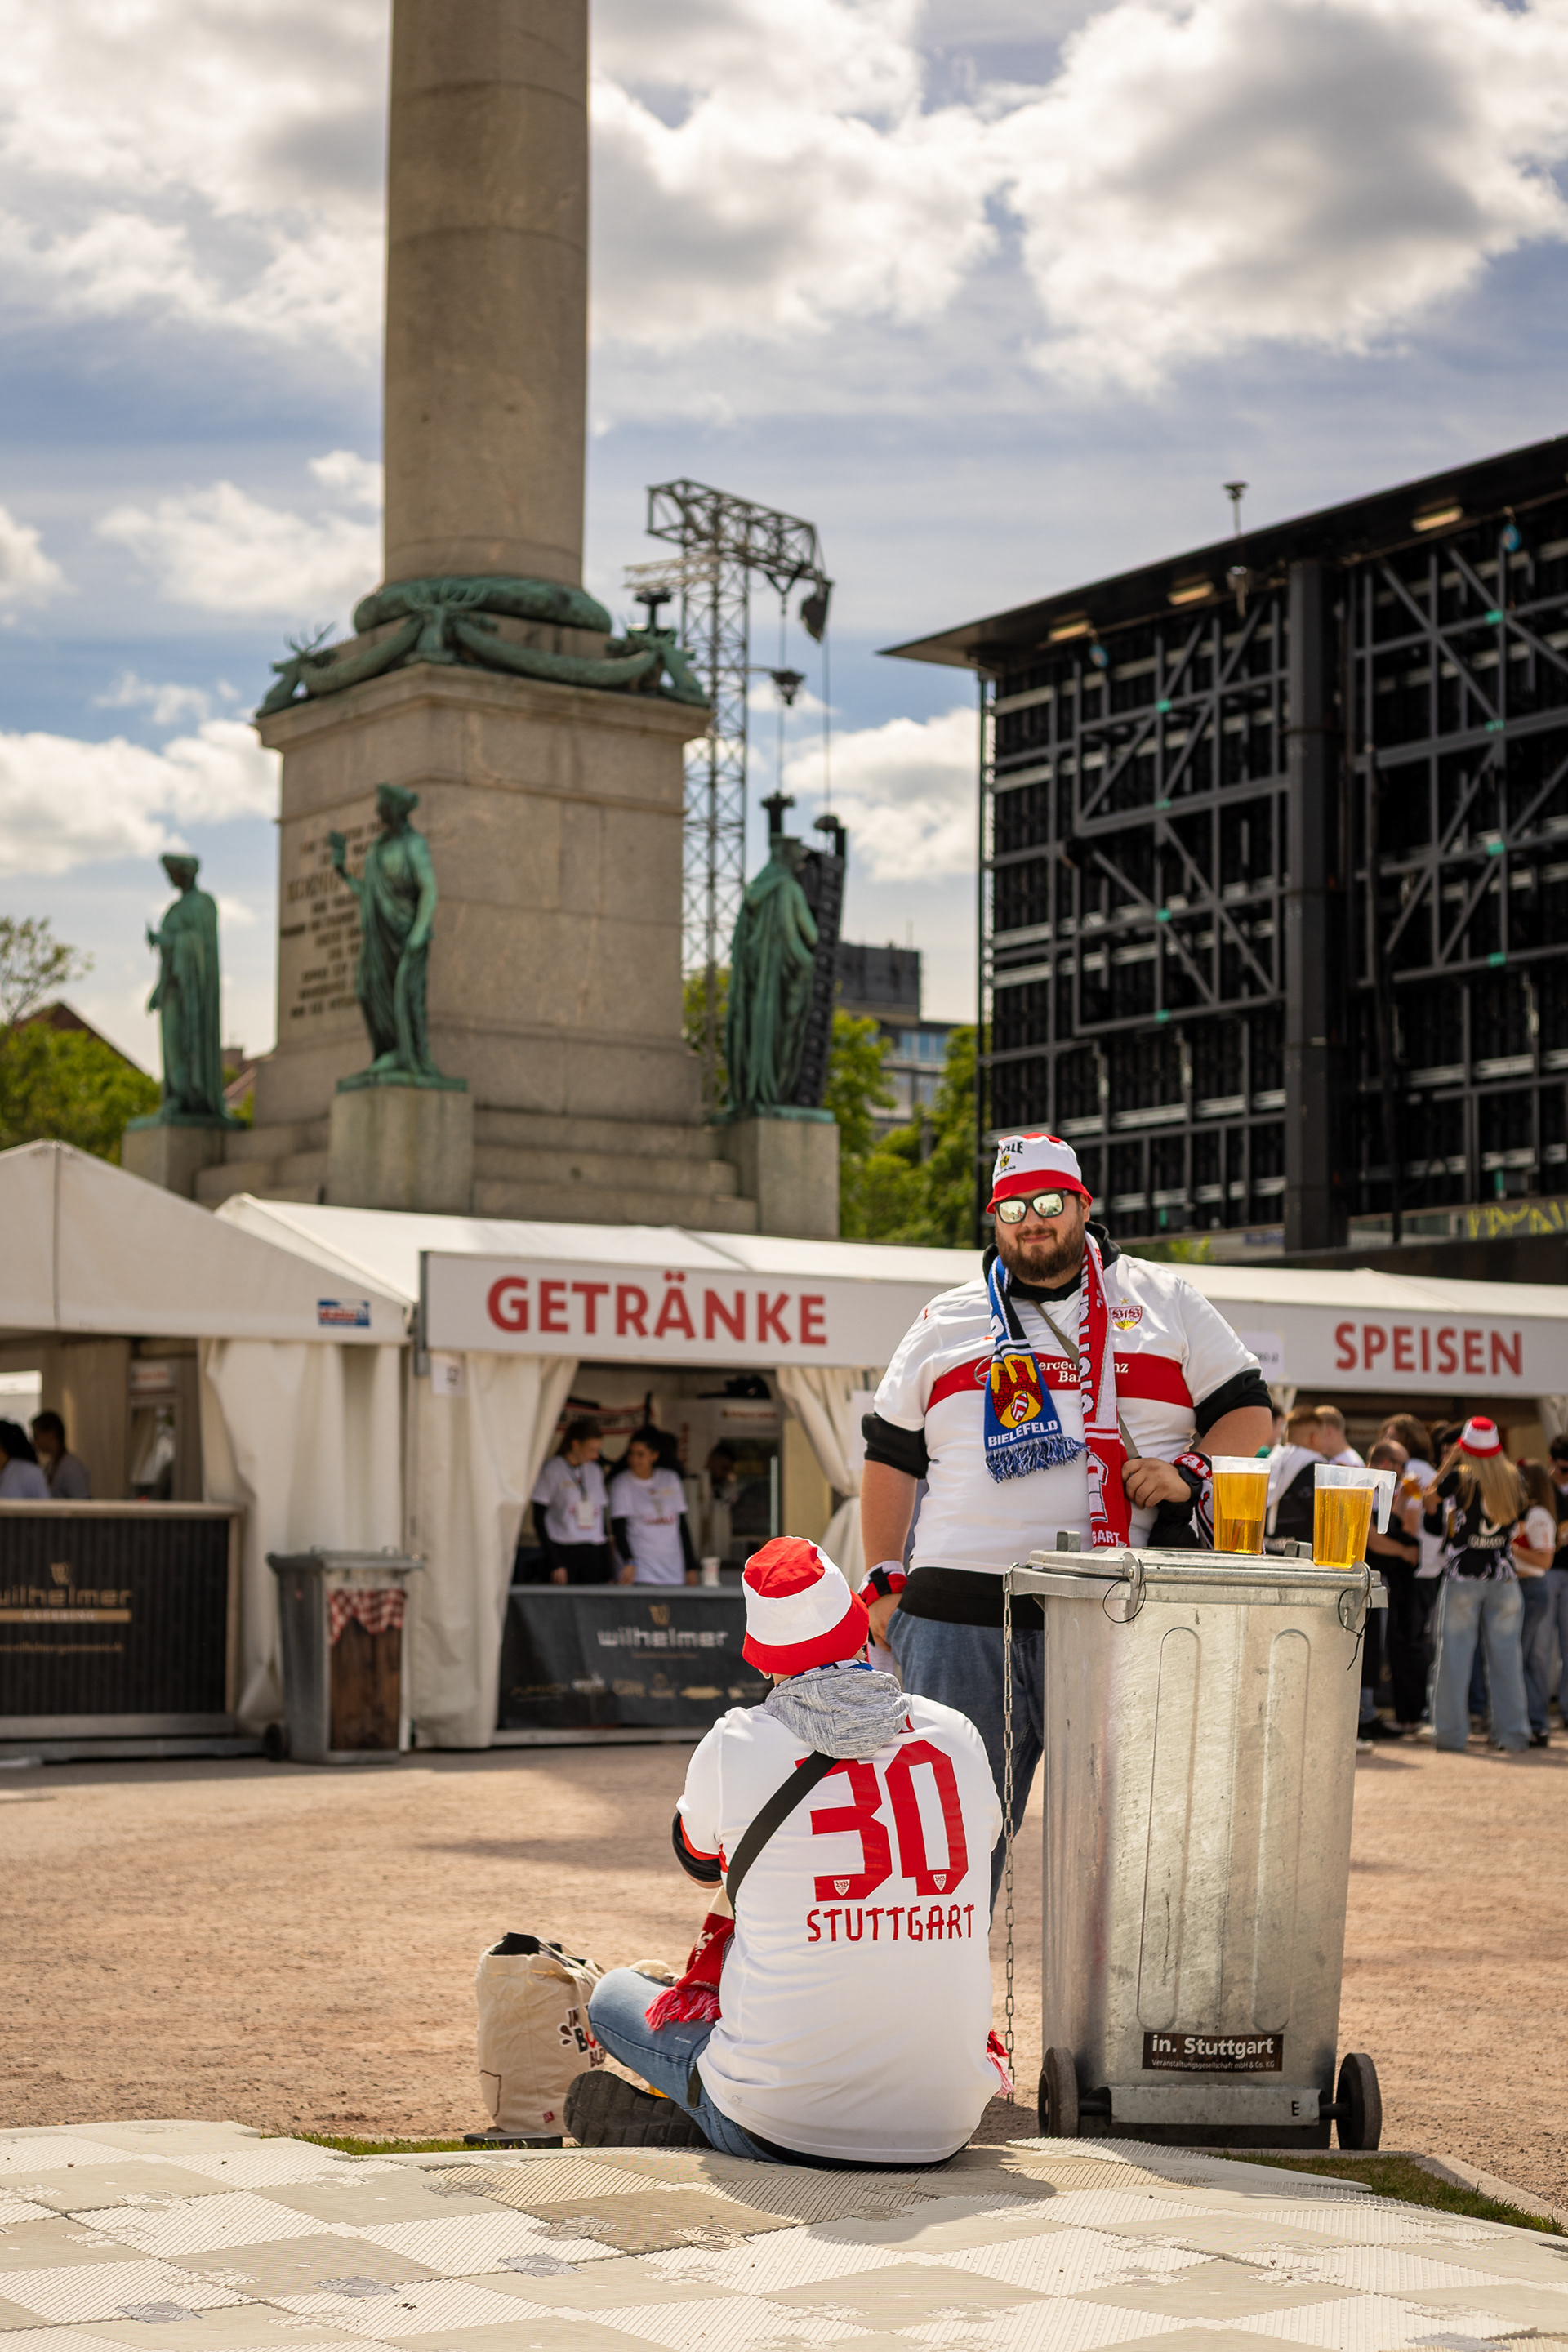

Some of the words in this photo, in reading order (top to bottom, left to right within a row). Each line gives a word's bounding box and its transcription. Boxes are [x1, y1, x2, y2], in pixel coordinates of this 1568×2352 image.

[487, 1270, 827, 1346] GETRÄNKE
[1334, 1321, 1523, 1377] SPEISEN
[988, 1419, 1058, 1447] BIELEFELD
[598, 1627, 729, 1648] wilhelmer
[794, 1739, 969, 1903] 30
[806, 1904, 975, 1942] STUTTGART
[1152, 2035, 1177, 2052] in.
[1184, 2038, 1274, 2060] Stuttgart
[1152, 2059, 1233, 2070] Veranstaltungsgesellschaft
[1291, 2100, 1300, 2117] E
